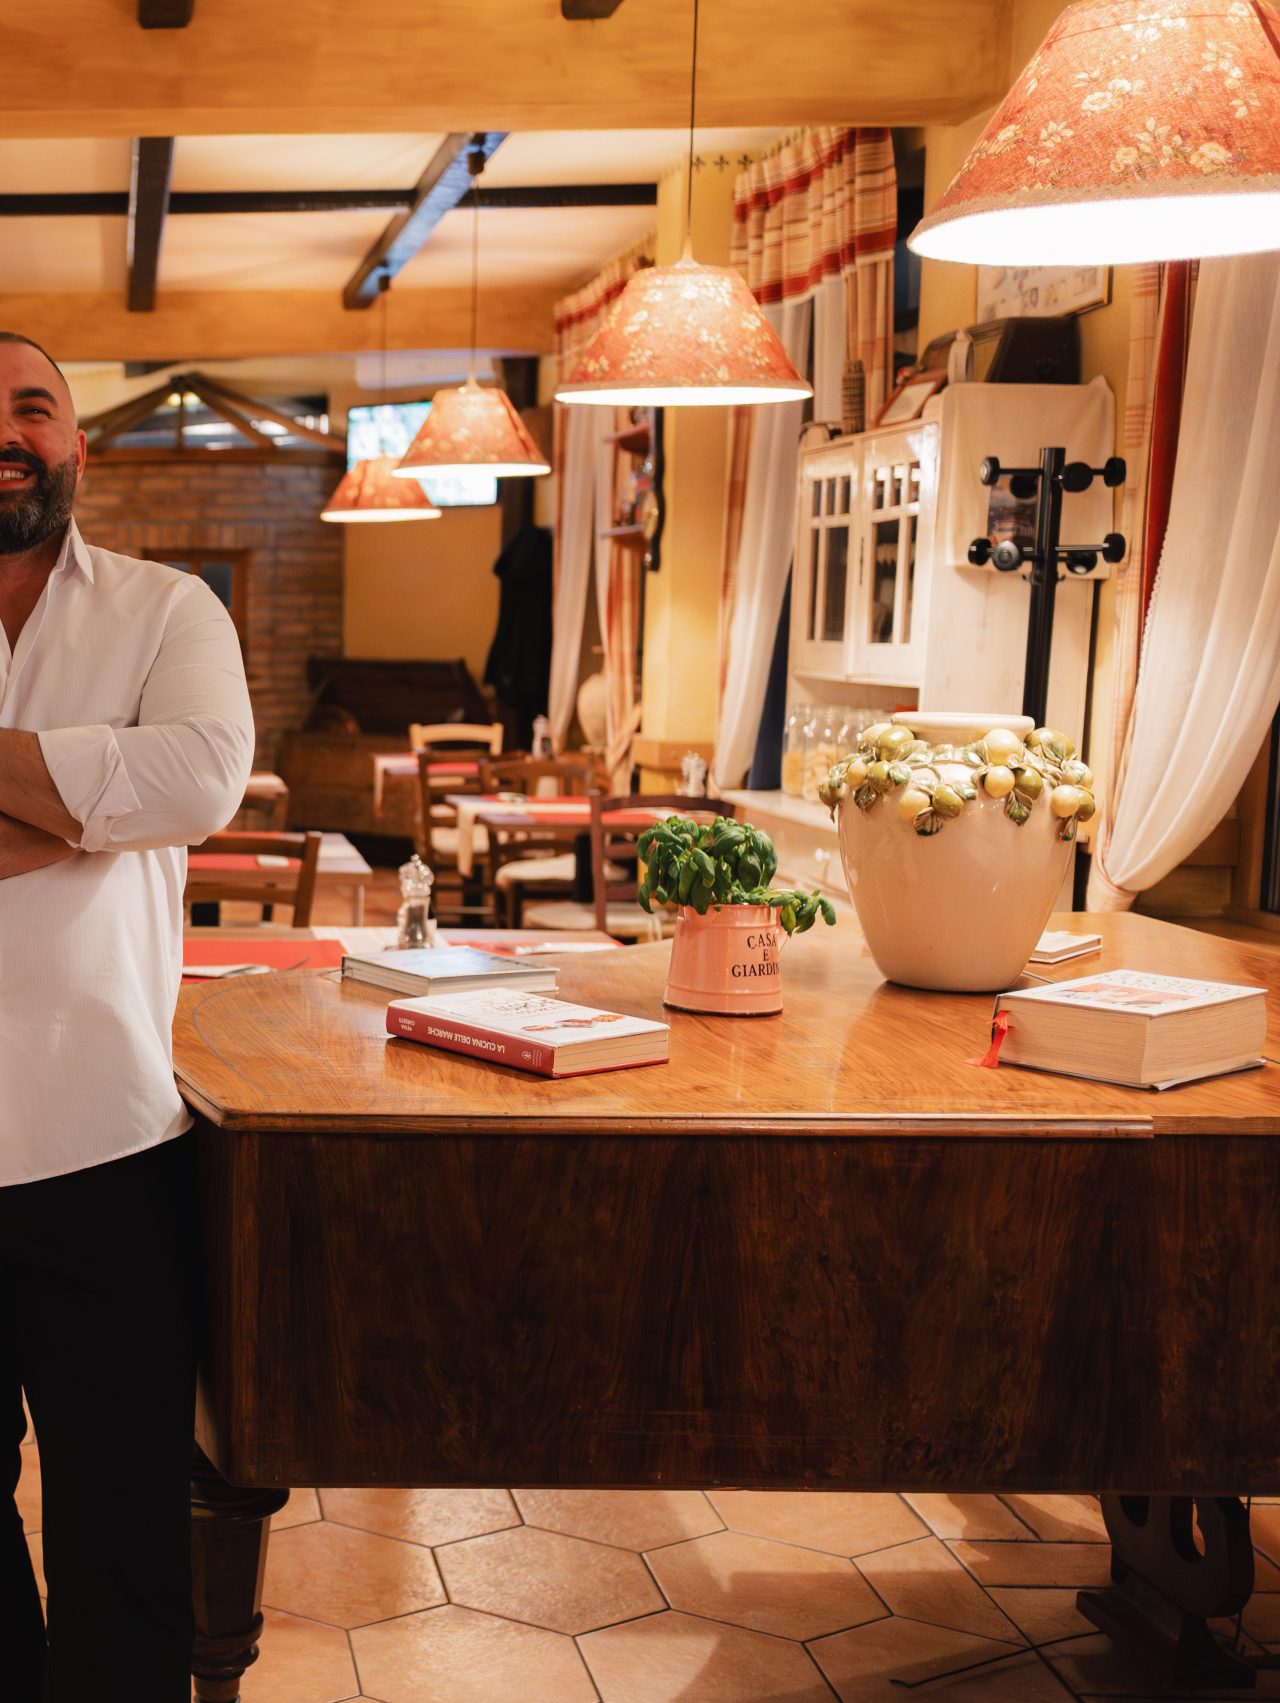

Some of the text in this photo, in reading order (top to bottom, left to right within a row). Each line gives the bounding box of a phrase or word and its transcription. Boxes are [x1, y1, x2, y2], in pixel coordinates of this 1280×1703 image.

[747, 933, 776, 949] CASA
[763, 949, 769, 961] E
[731, 962, 779, 977] GIARDIN
[427, 1026, 506, 1054] LA CUCINA DELLE MARCHE
